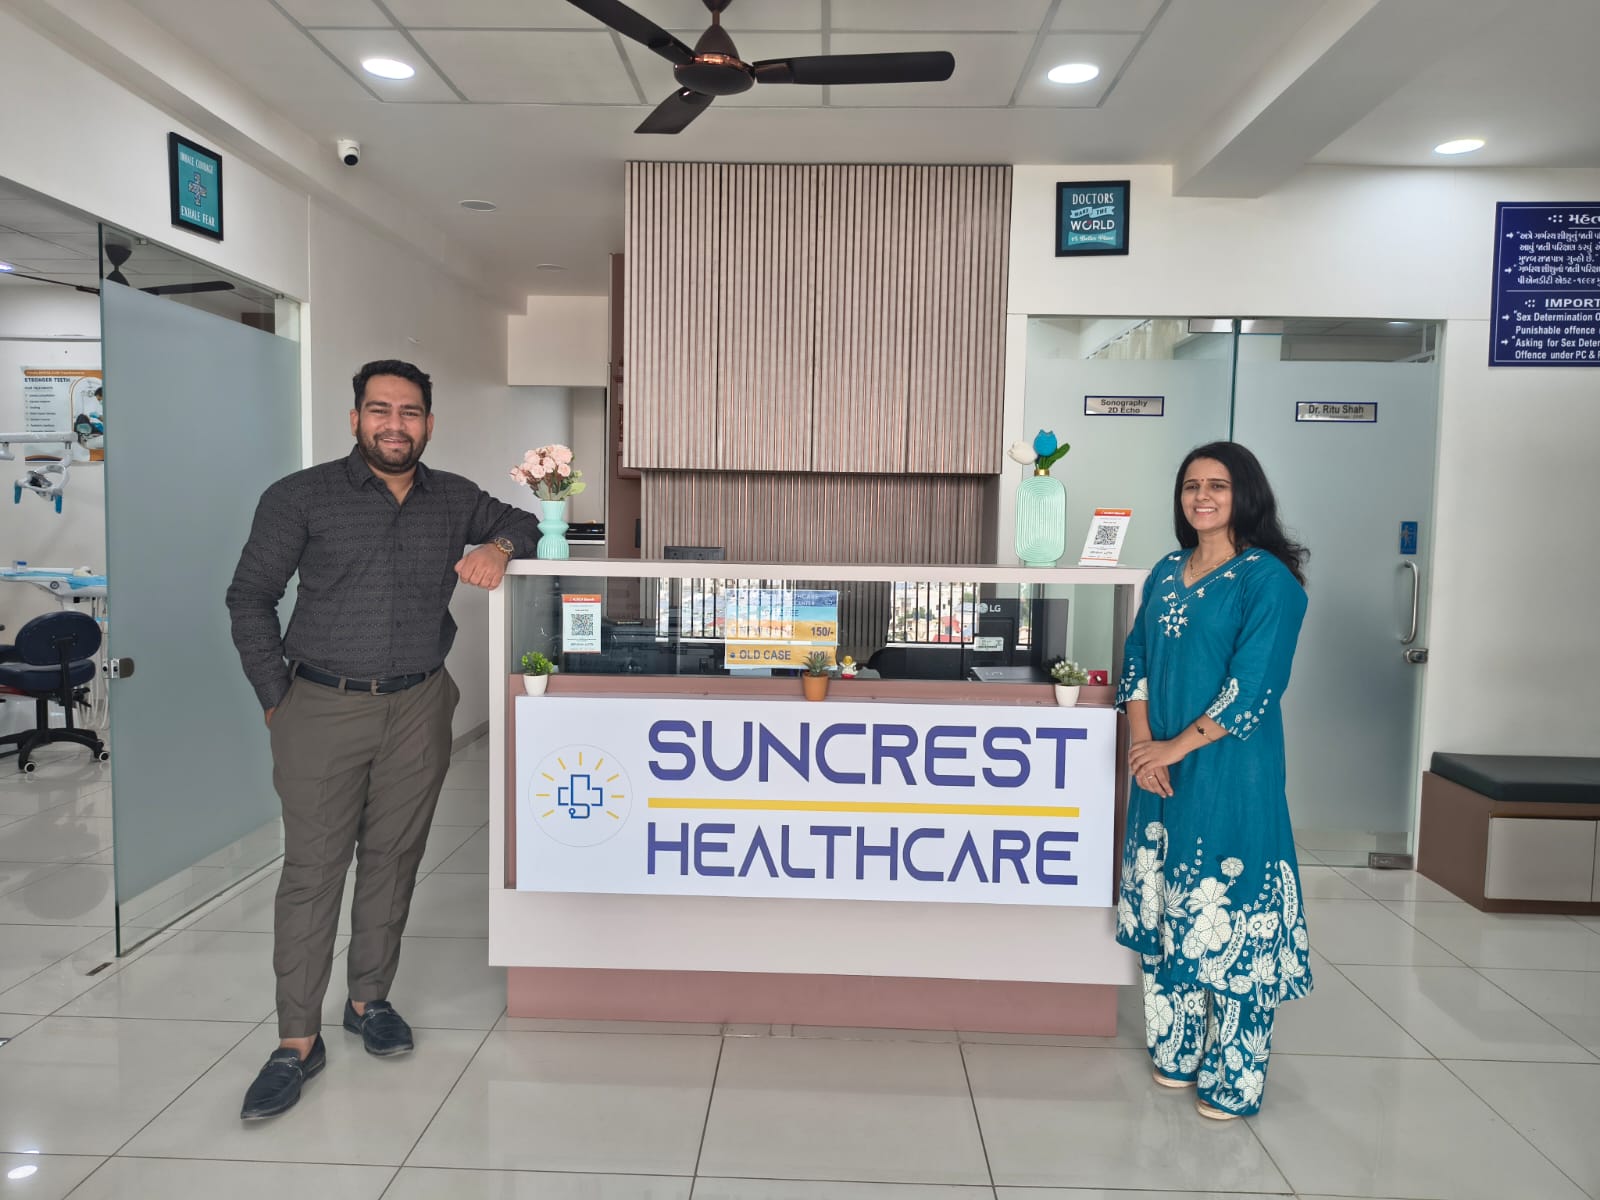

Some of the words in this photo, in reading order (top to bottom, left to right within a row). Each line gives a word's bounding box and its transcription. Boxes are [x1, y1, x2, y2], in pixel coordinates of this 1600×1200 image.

[1072, 192, 1114, 205] DOCTORS
[181, 205, 201, 222] EXHALE
[202, 213, 215, 227] FEAR
[1070, 219, 1115, 231] WORLD
[1533, 312, 1593, 321] Determination
[1515, 325, 1561, 335] Punishable
[1564, 325, 1596, 335] offence
[1547, 338, 1559, 347] for
[1560, 338, 1576, 347] Sex
[1515, 350, 1547, 359] Offence
[1550, 350, 1574, 359] under
[1575, 350, 1587, 359] PC
[1588, 350, 1595, 359] &
[1100, 398, 1148, 408] Sonography
[1308, 405, 1320, 415] Dr.
[1322, 405, 1340, 414] Ritu
[1342, 405, 1364, 414] Shah
[989, 604, 1001, 613] LG
[811, 626, 834, 637] 150/-
[739, 649, 761, 660] OLD
[763, 650, 791, 660] CASE
[648, 719, 1088, 789] SUNCREST
[647, 821, 1079, 886] HEALTHCARE
